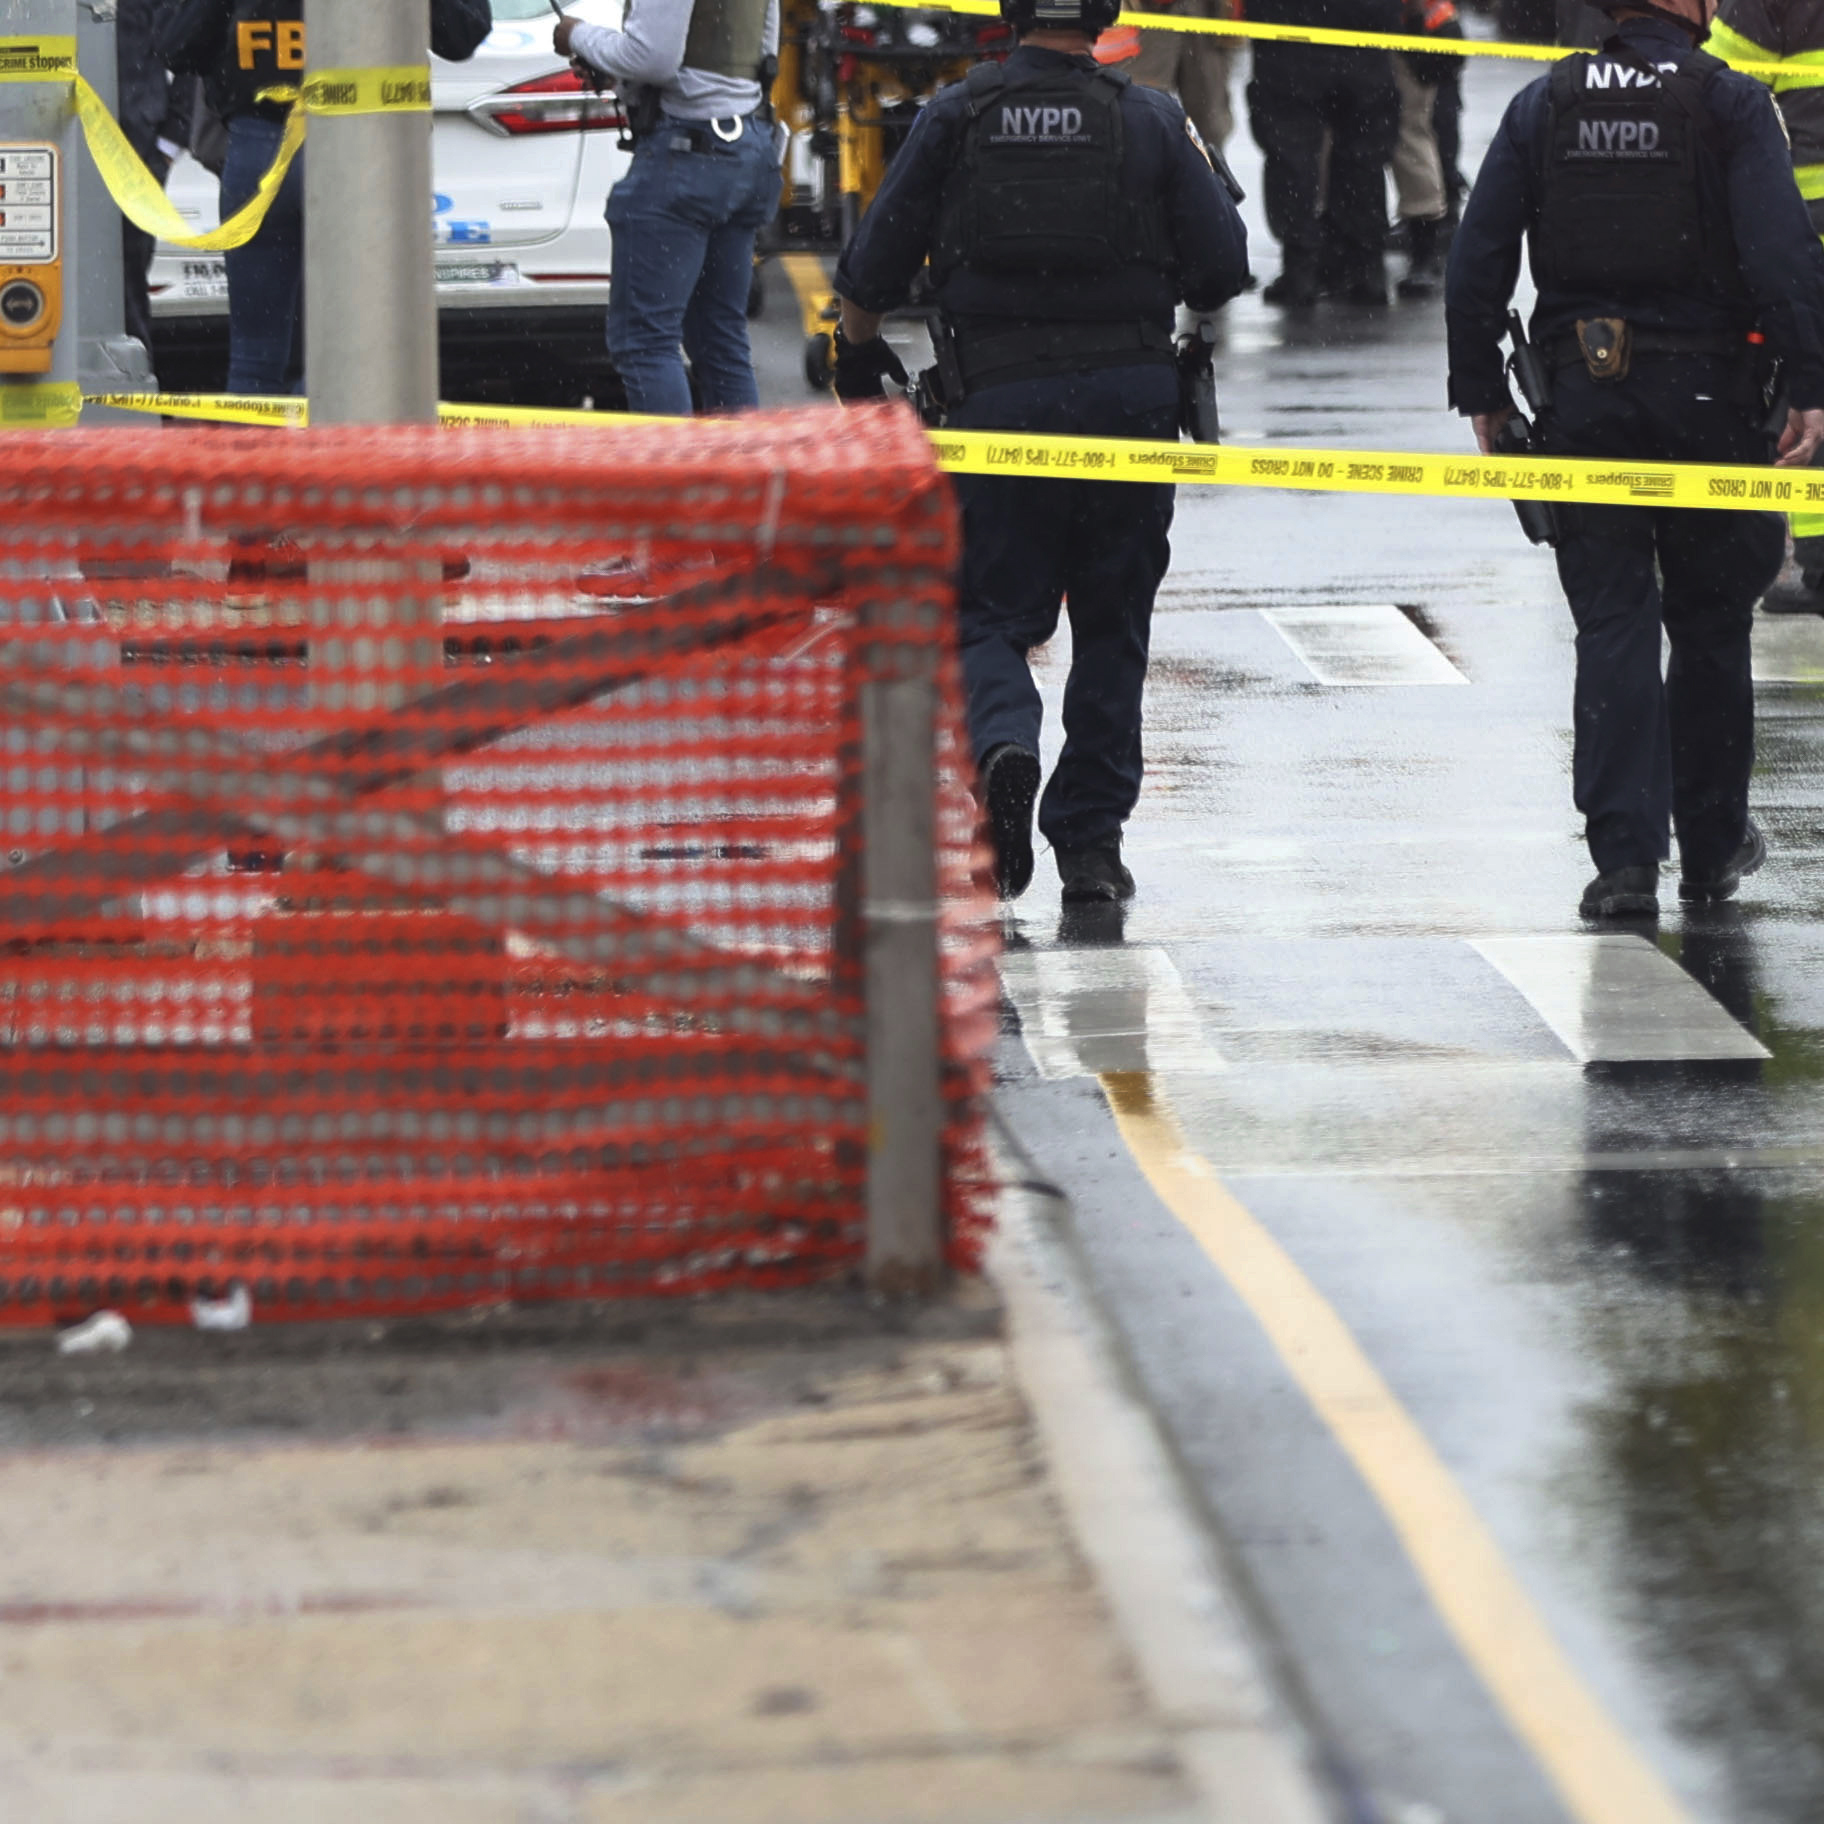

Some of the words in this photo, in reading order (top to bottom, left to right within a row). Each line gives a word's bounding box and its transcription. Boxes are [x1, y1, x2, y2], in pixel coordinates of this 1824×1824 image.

[1002, 107, 1082, 135] NYPD
[1579, 121, 1660, 150] NYPD
[986, 446, 1023, 466] (8477)
[1025, 447, 1115, 468] 1-800-577-TIPS
[1250, 459, 1289, 476] CROSS
[1291, 460, 1315, 477] NOT
[1317, 462, 1334, 478] DO
[1347, 463, 1384, 481] SCENE
[1386, 465, 1424, 483] CRIME
[1443, 467, 1481, 488] (8477)
[1482, 470, 1574, 491] 1-800-577-TIPS
[1708, 478, 1747, 497] CROSS
[1748, 480, 1773, 499] NOT
[1776, 481, 1792, 500] DO
